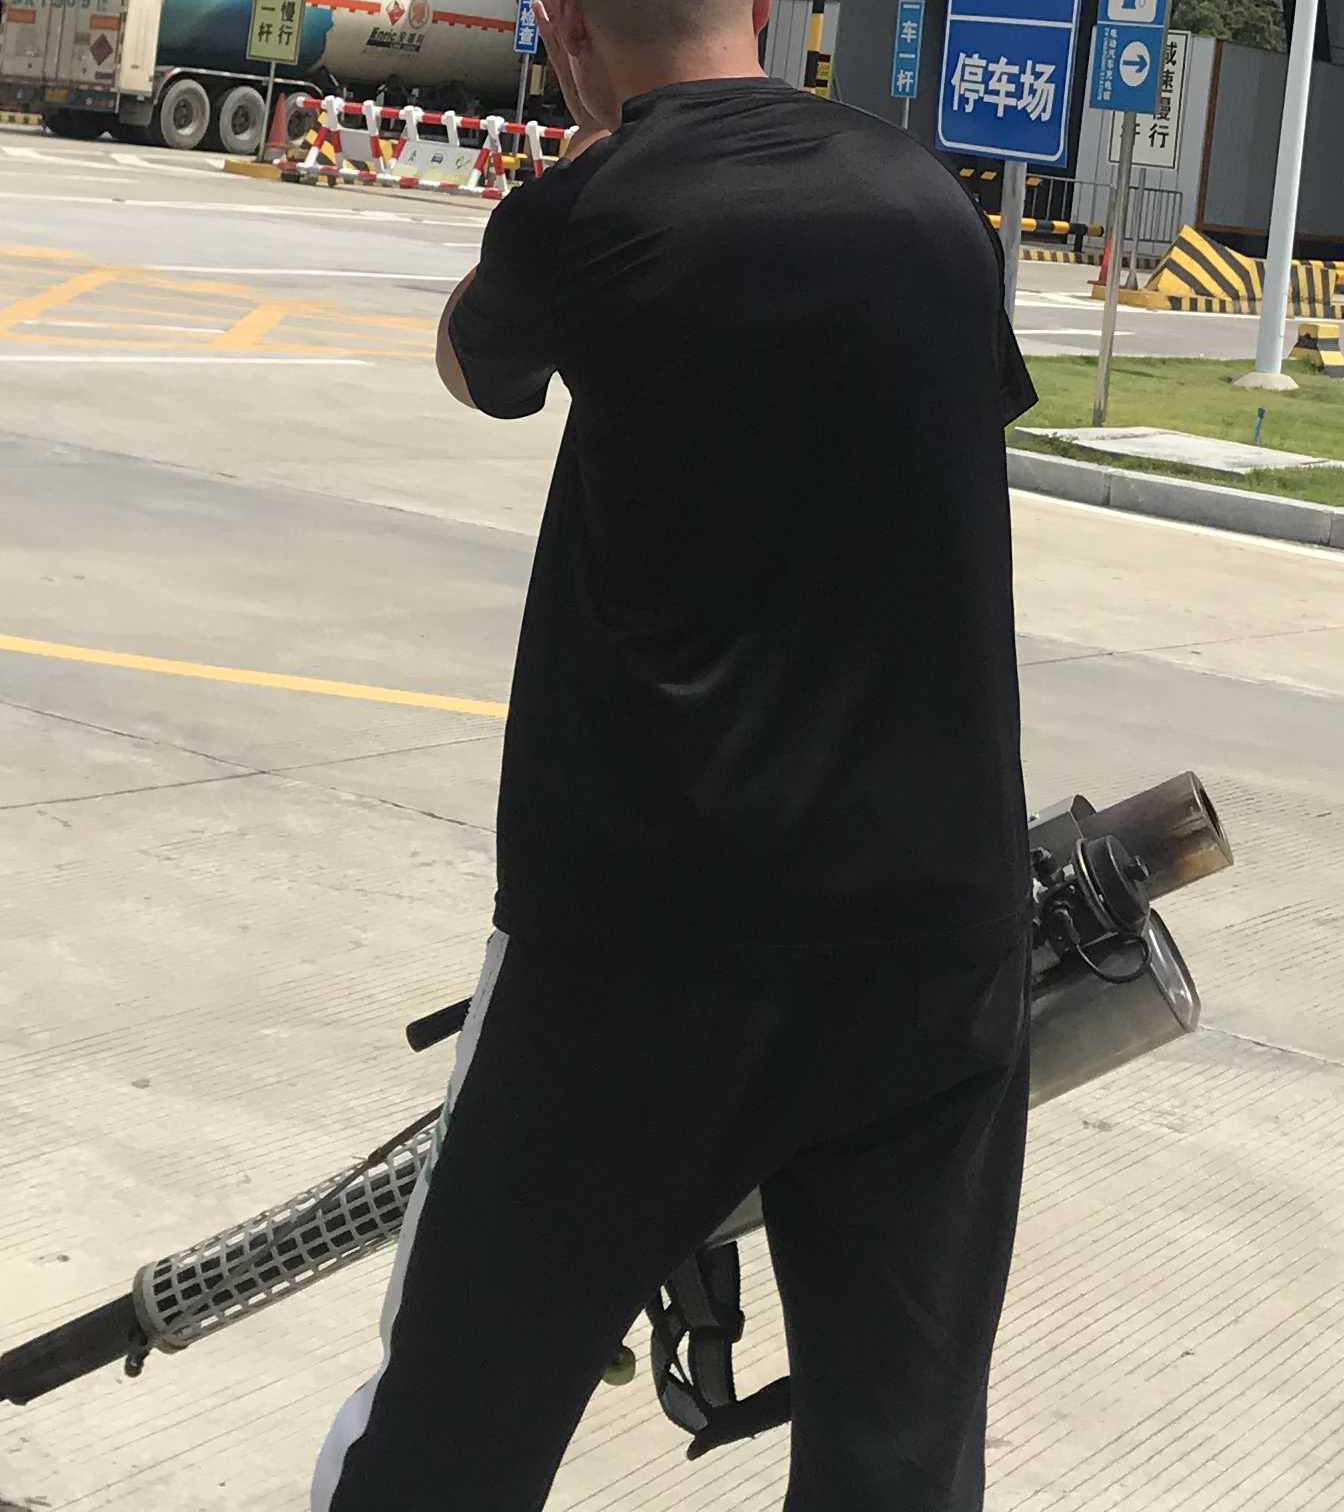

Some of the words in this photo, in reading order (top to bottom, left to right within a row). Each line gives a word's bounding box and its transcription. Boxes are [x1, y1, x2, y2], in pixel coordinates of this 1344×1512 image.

[896, 4, 921, 93] 一车一杆
[950, 51, 1057, 122] 停车场
